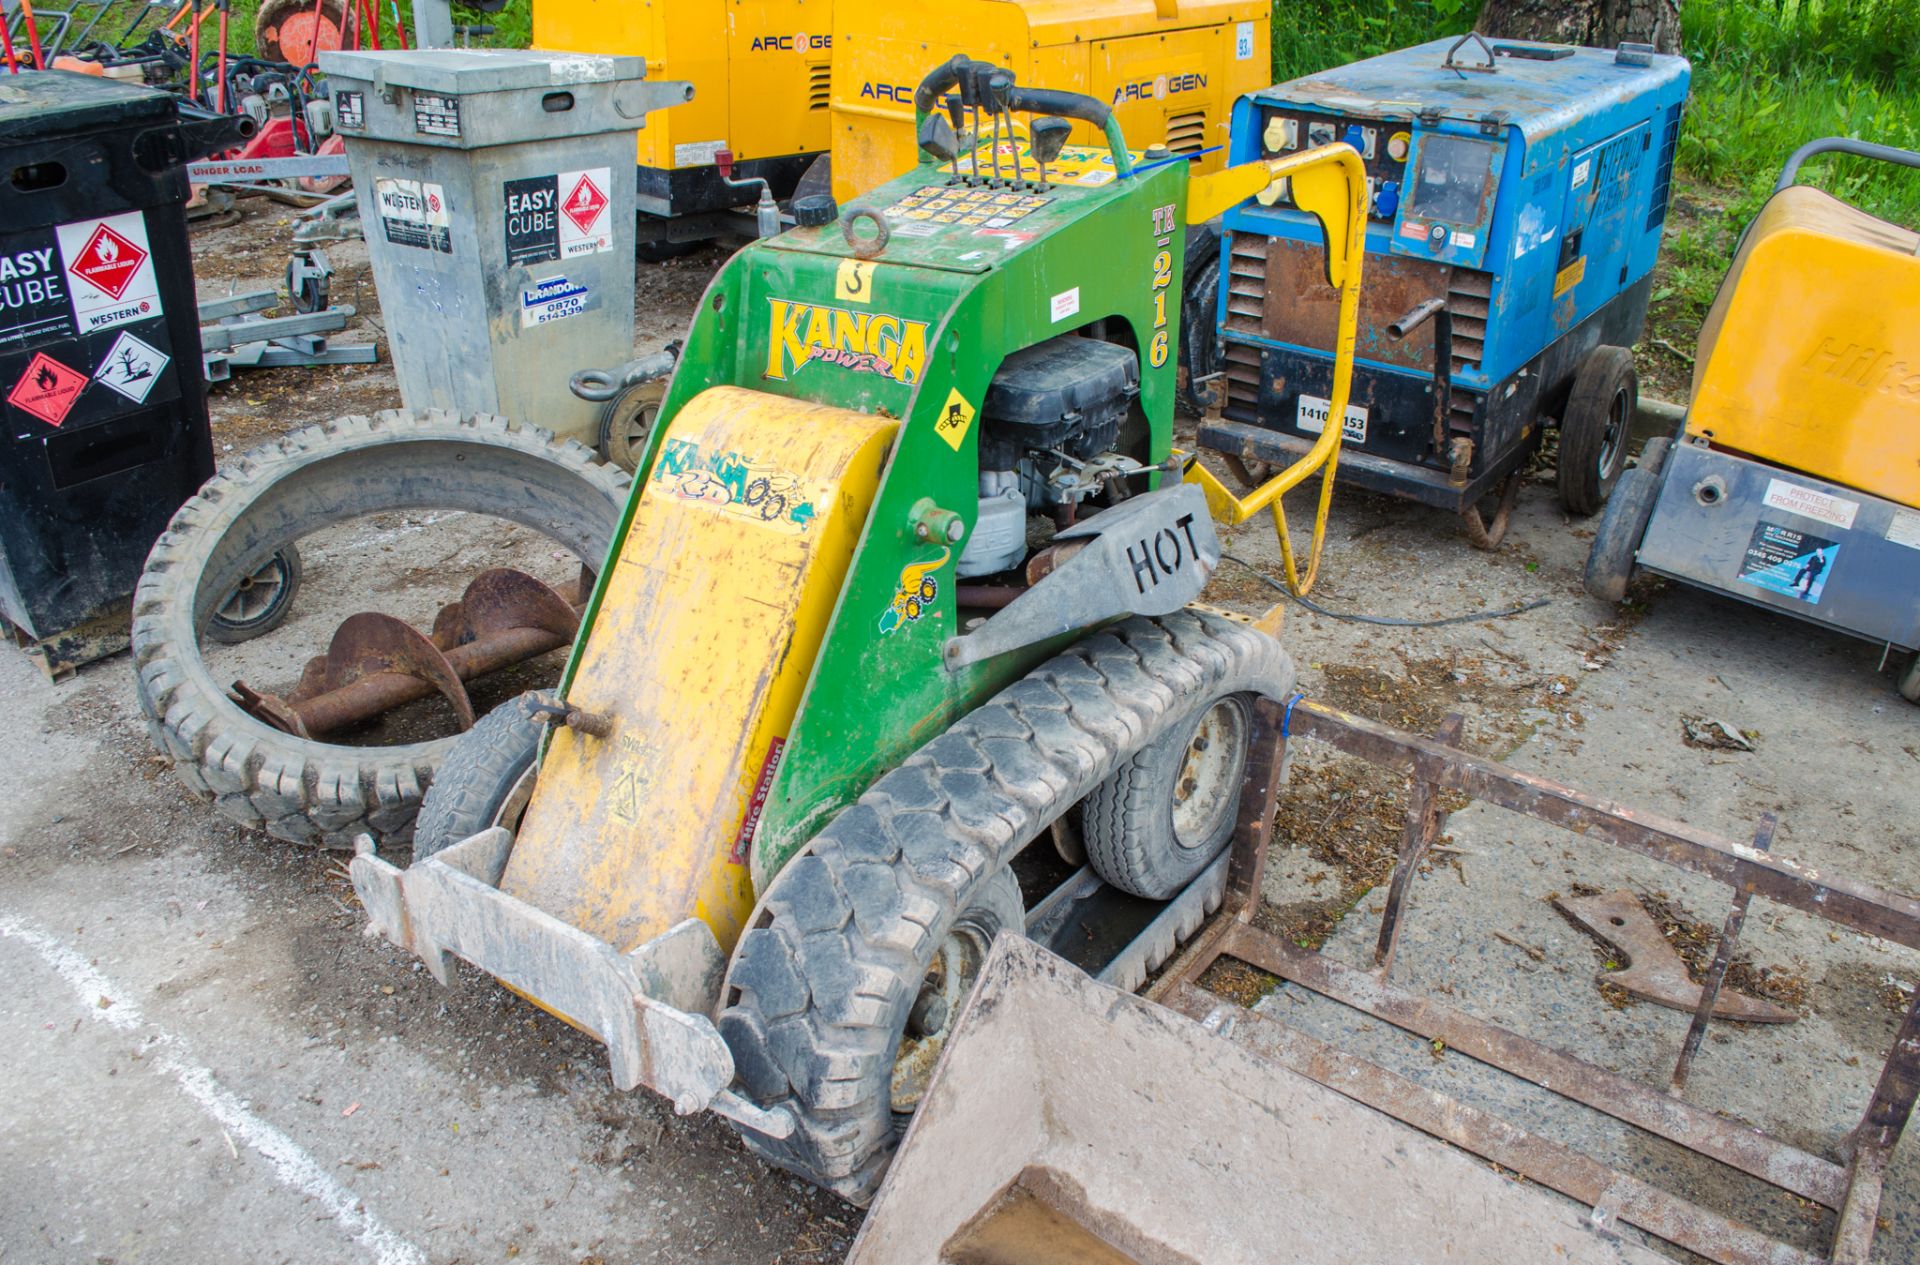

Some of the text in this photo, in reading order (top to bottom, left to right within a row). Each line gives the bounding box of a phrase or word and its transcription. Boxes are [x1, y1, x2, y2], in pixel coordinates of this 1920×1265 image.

[751, 35, 832, 51] ARC GE
[860, 82, 912, 104] ARC
[1112, 72, 1207, 105] ARC GEN
[193, 167, 229, 176] UNDER
[509, 189, 554, 214] EASY
[509, 211, 554, 236] CUBE
[568, 241, 598, 254] WESTERN
[85, 259, 135, 275] FLAMMABLE LIQUID
[0, 275, 63, 311] UBE
[539, 305, 582, 322] 514339
[547, 298, 579, 312] 0870
[90, 306, 139, 326] WESTERN
[766, 297, 931, 386] KANGA
[808, 345, 897, 379] POWER
[25, 386, 75, 404] FLAMMABLE LIQUID
[1789, 487, 1834, 507] PROTECT
[1770, 494, 1847, 525] FROM FREEZING
[1126, 513, 1200, 595] HOT
[1767, 555, 1783, 564] 409
[743, 744, 784, 839] Hire Station
